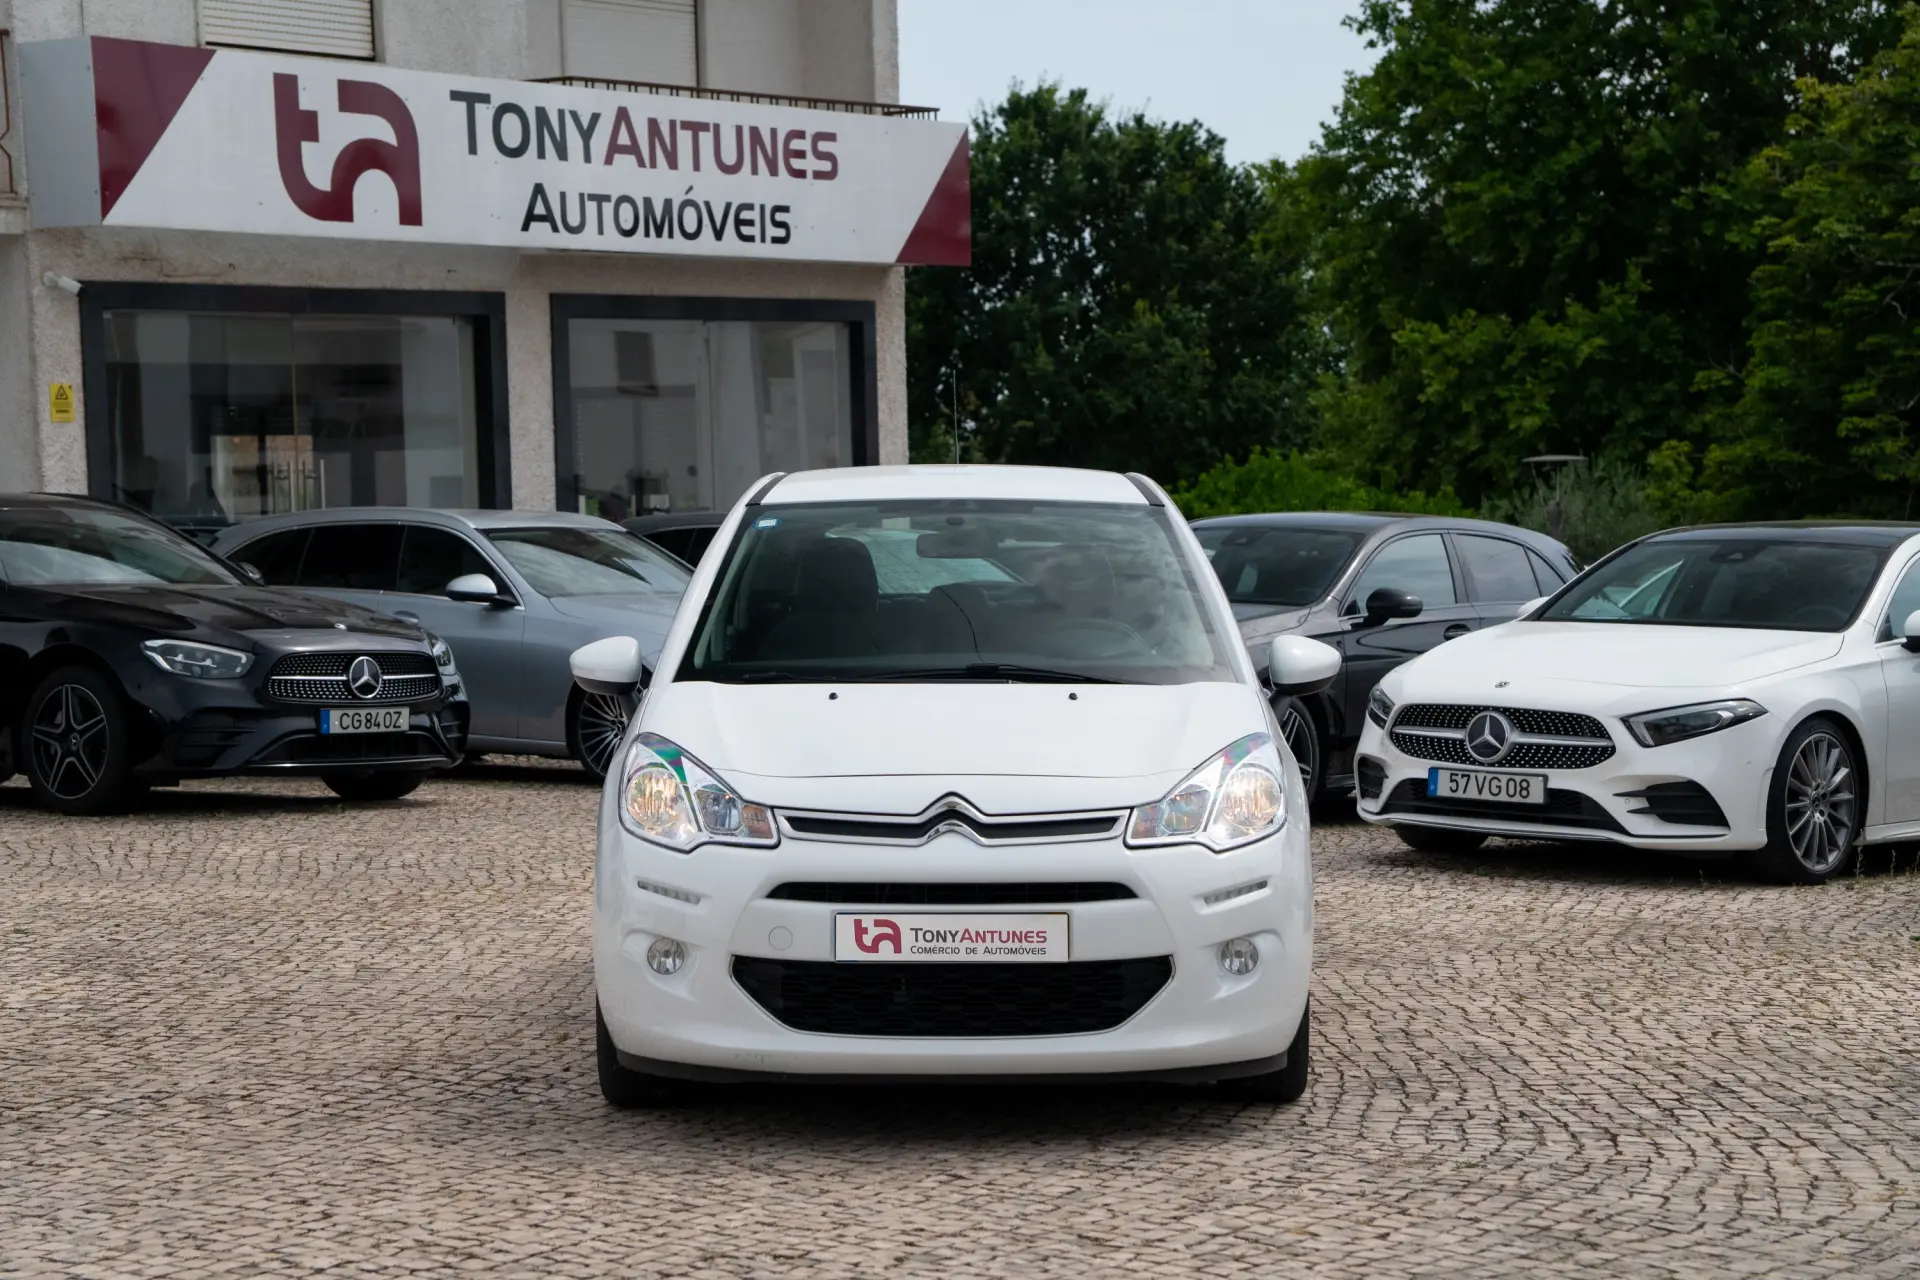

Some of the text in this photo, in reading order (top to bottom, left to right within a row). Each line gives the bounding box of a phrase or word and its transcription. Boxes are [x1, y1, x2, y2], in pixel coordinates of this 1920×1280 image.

[520, 182, 791, 244] AUTOMÓVEIS
[910, 944, 1047, 955] COMÉRCIO DE AUTOMÓVEIS
